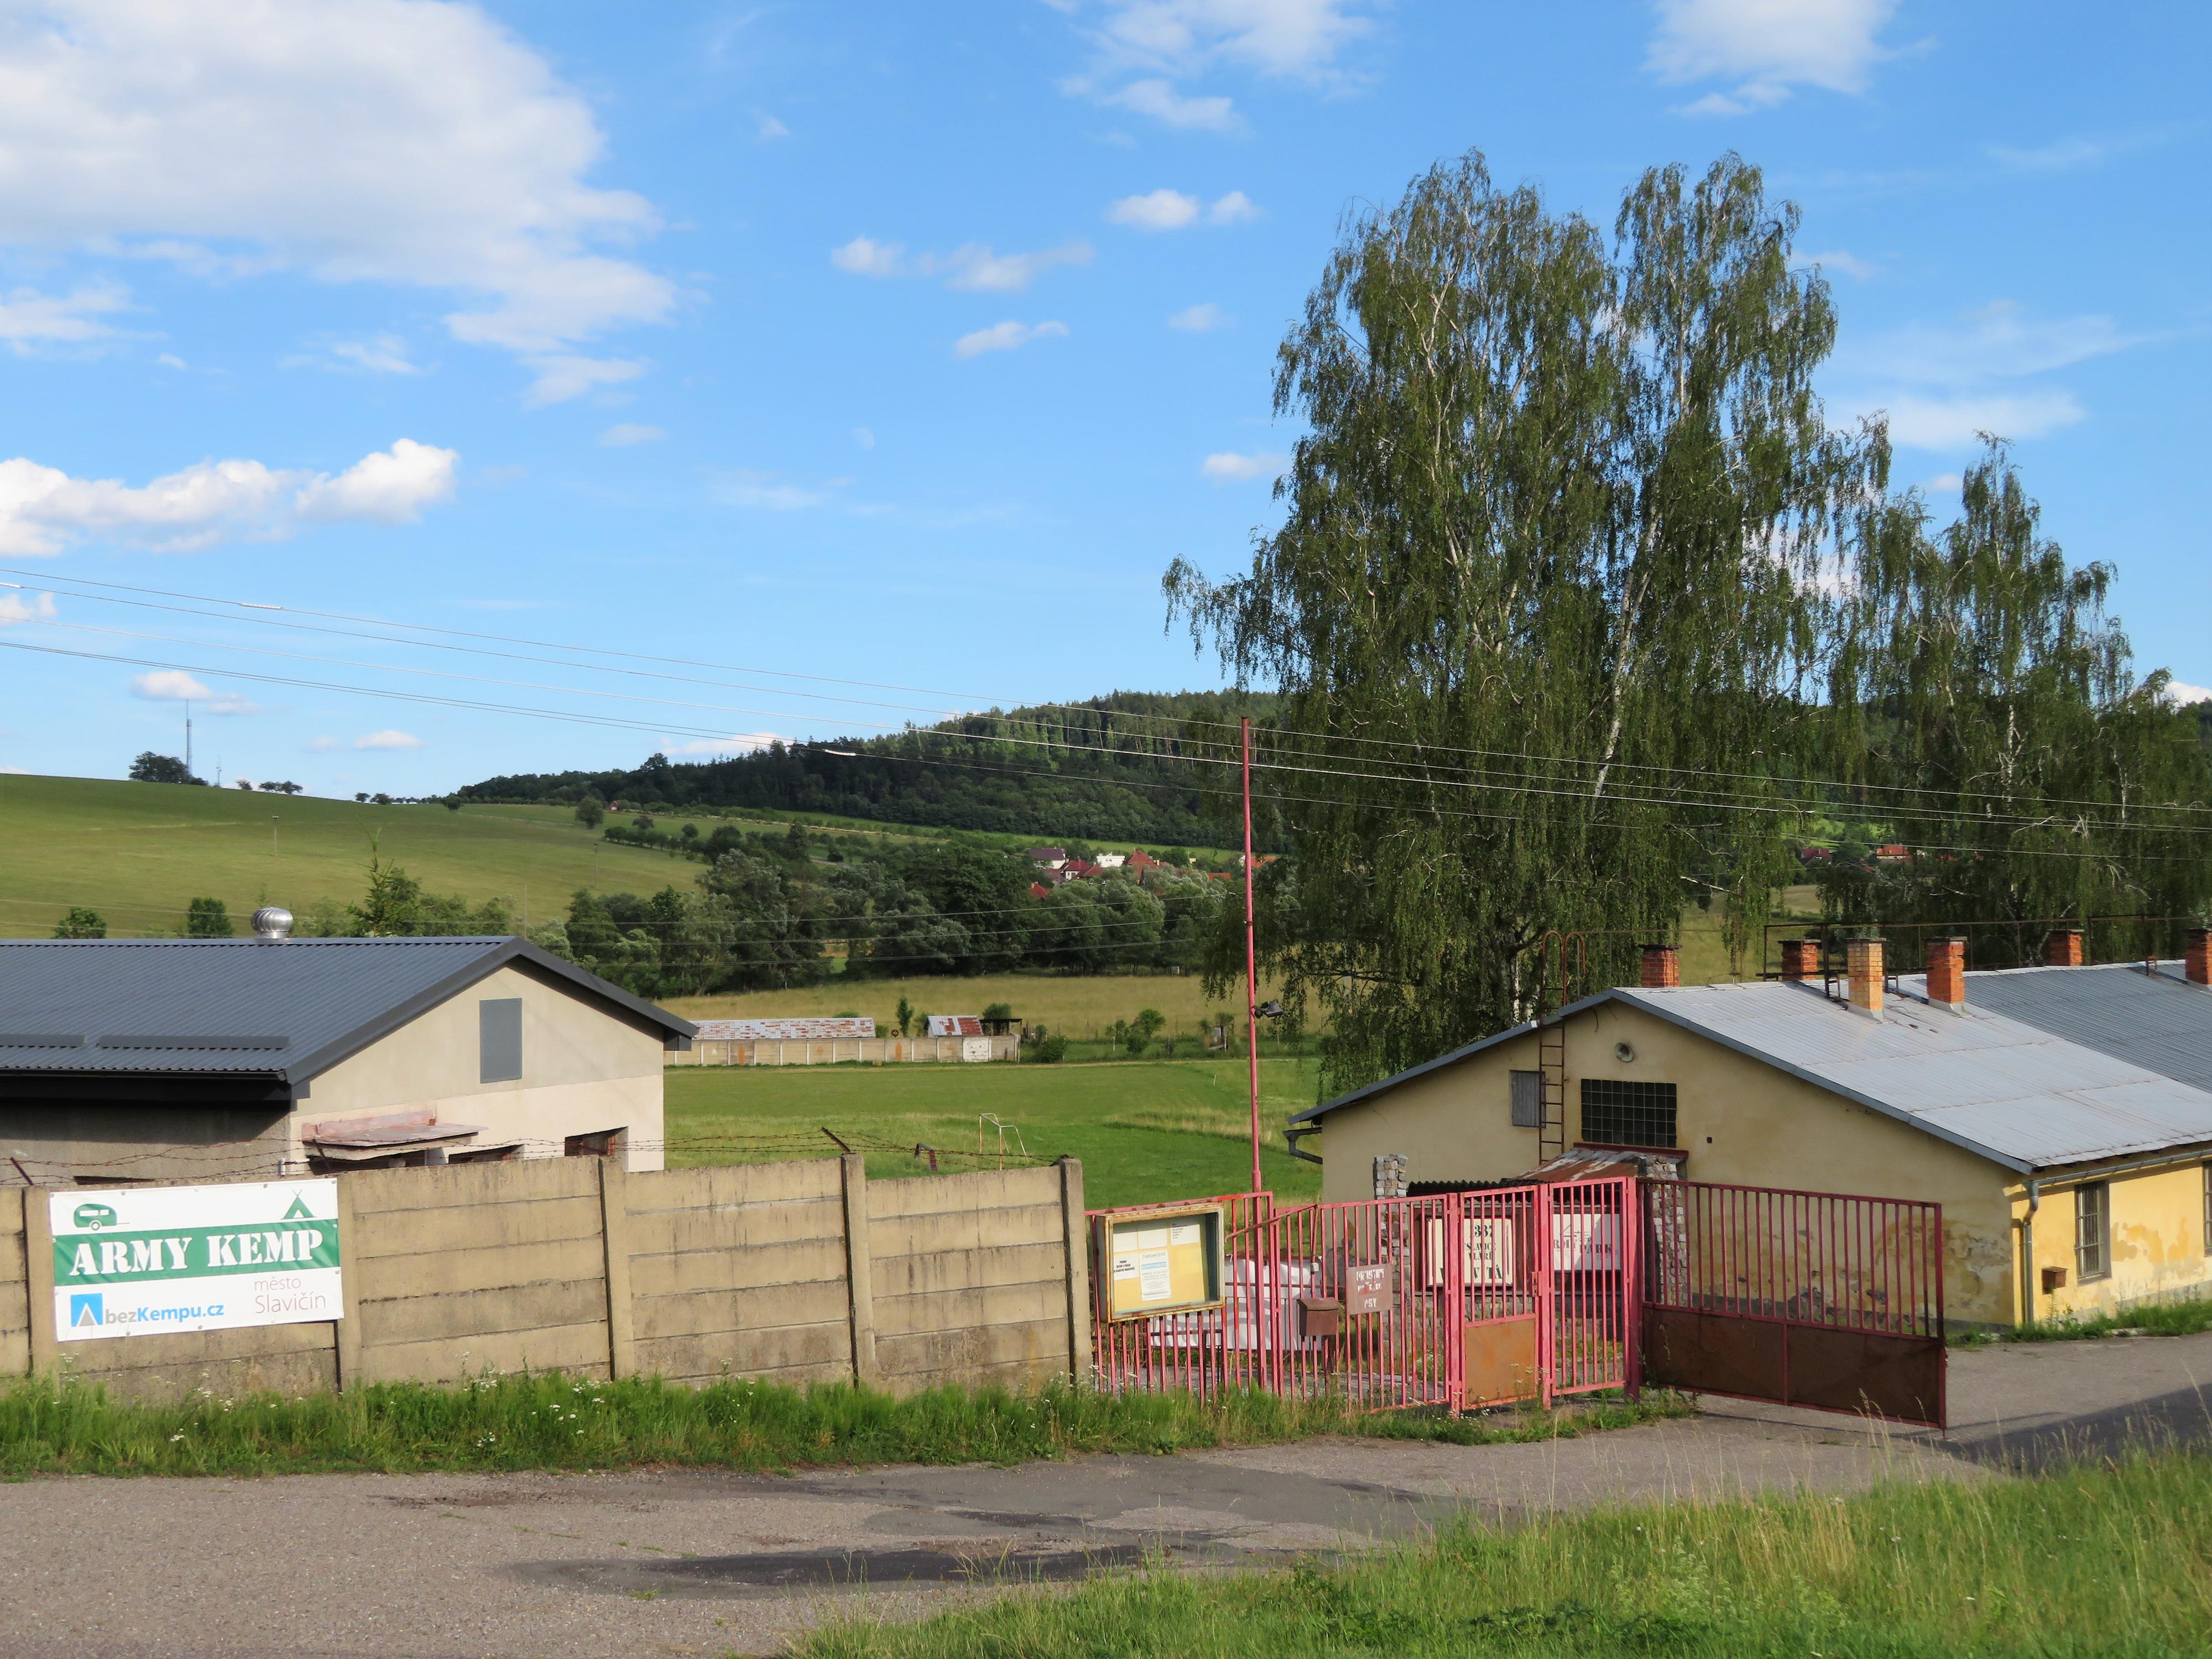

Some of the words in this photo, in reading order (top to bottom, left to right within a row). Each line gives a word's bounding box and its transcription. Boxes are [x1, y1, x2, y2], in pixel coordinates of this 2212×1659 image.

[69, 1236, 193, 1276] ARMY
[206, 1229, 324, 1267] KEMP
[254, 1276, 301, 1292] město
[255, 1291, 326, 1314] Slavičín
[1364, 1297, 1377, 1308] PSY
[106, 1304, 225, 1326] bezKempu.cz
